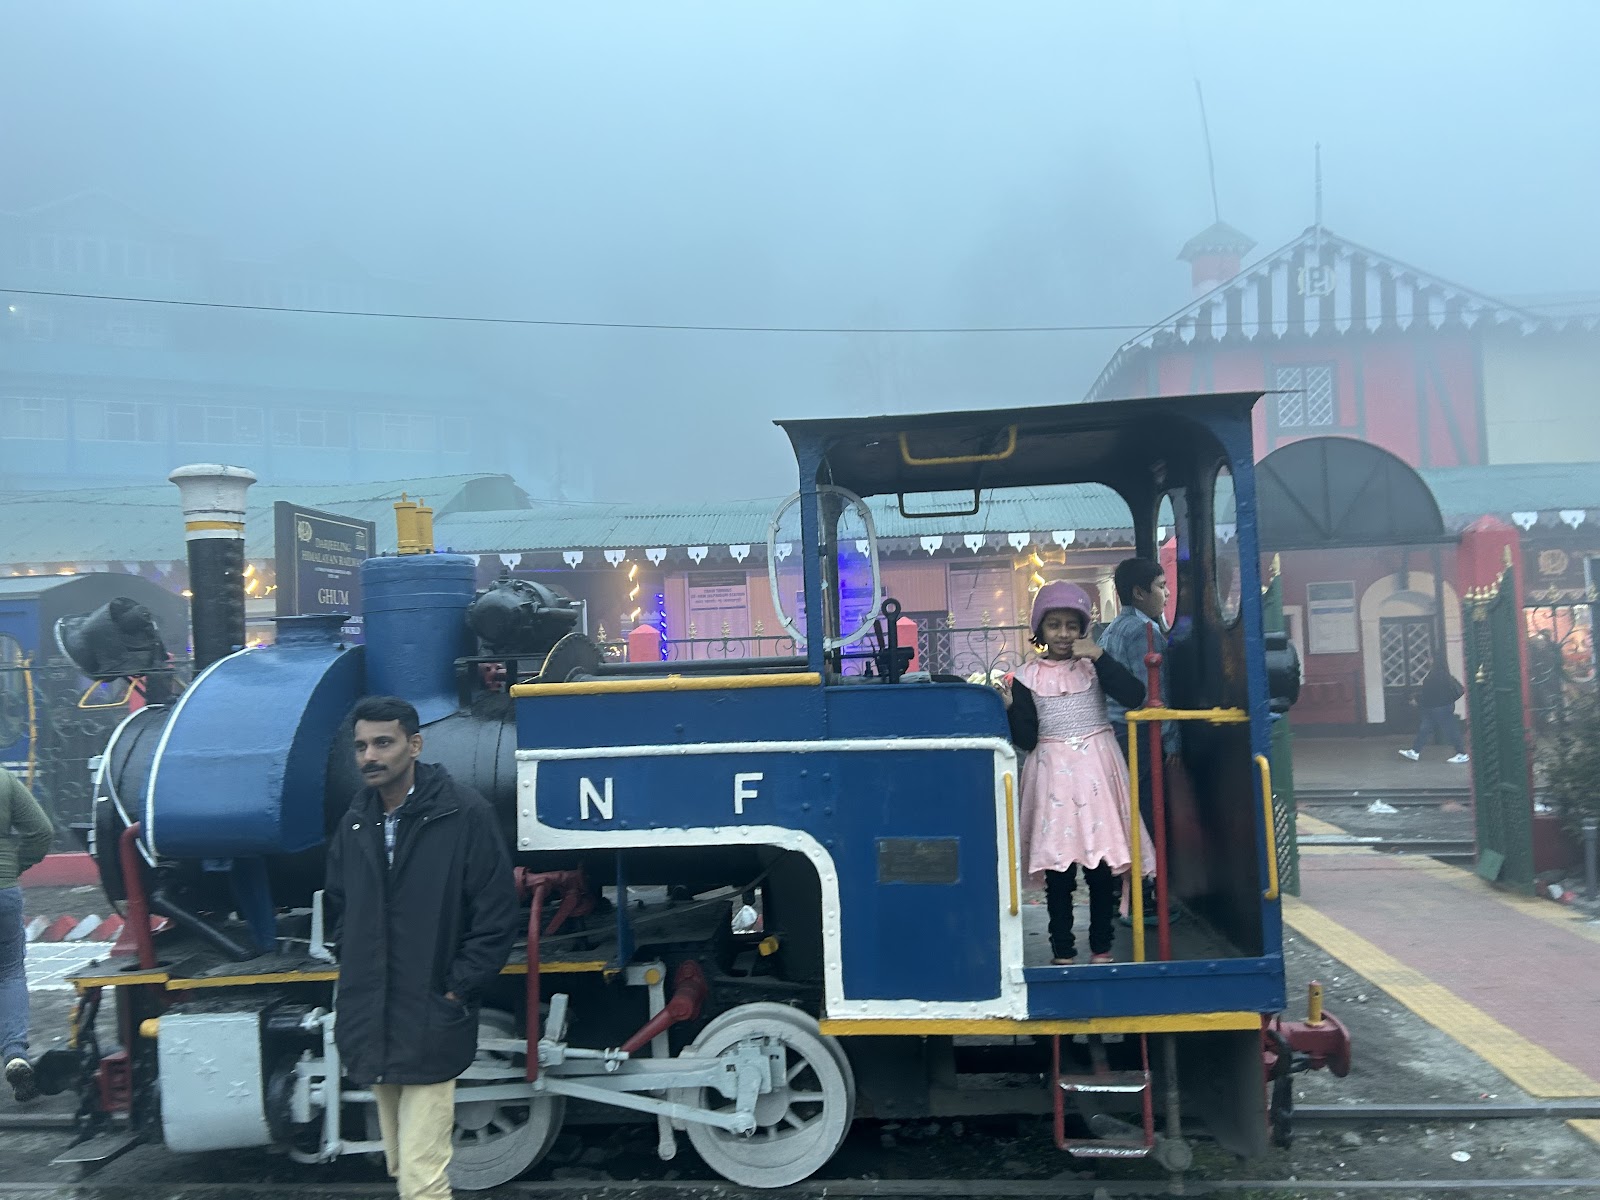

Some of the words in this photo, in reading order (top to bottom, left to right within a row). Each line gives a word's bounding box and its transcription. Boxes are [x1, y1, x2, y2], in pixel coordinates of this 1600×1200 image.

[317, 588, 349, 605] GHUM
[580, 777, 613, 820] N
[734, 772, 763, 814] F
